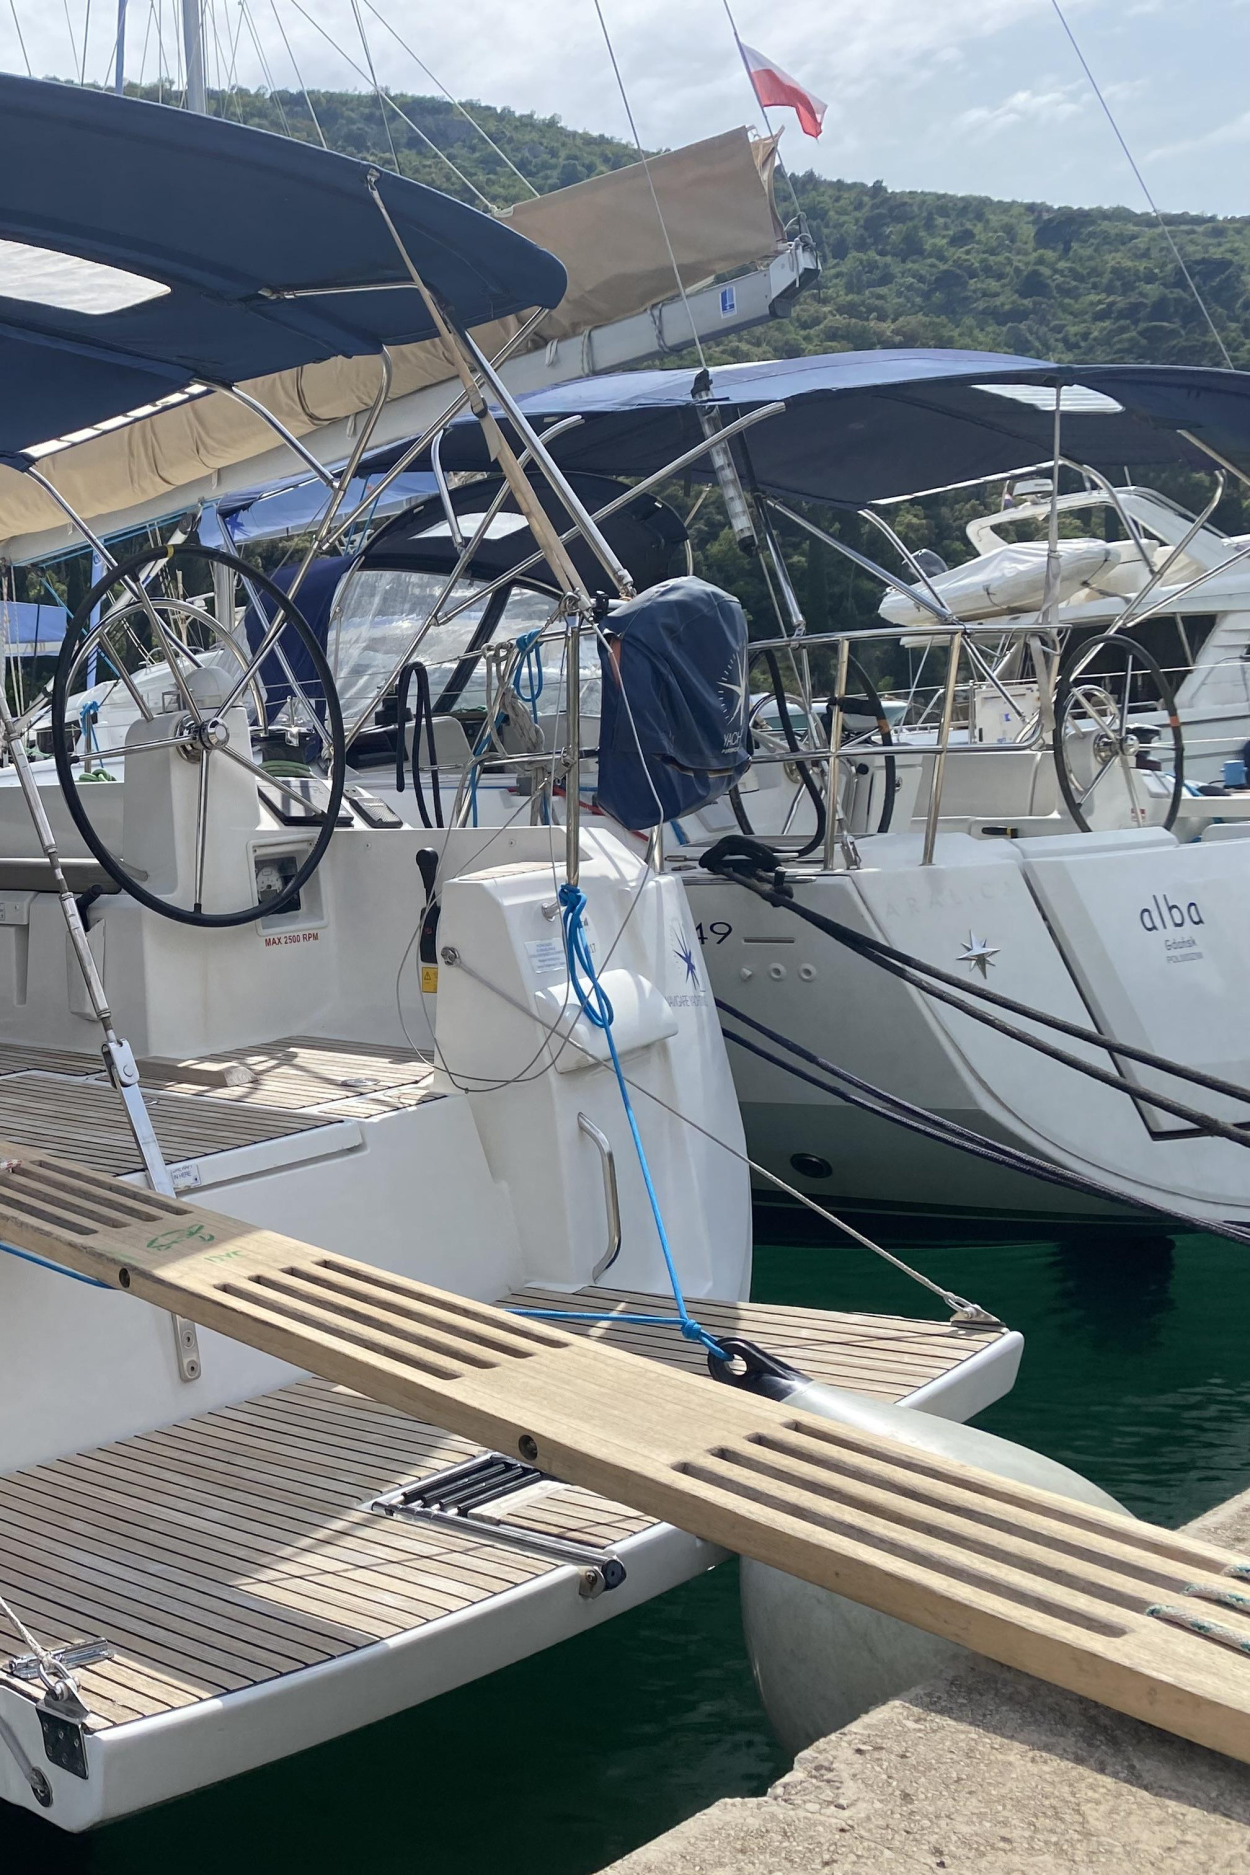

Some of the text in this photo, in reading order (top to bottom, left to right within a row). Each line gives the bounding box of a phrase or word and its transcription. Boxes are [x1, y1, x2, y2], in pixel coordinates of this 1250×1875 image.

[1139, 893, 1205, 932] alba
[264, 932, 319, 947] MAX 2500 RPM
